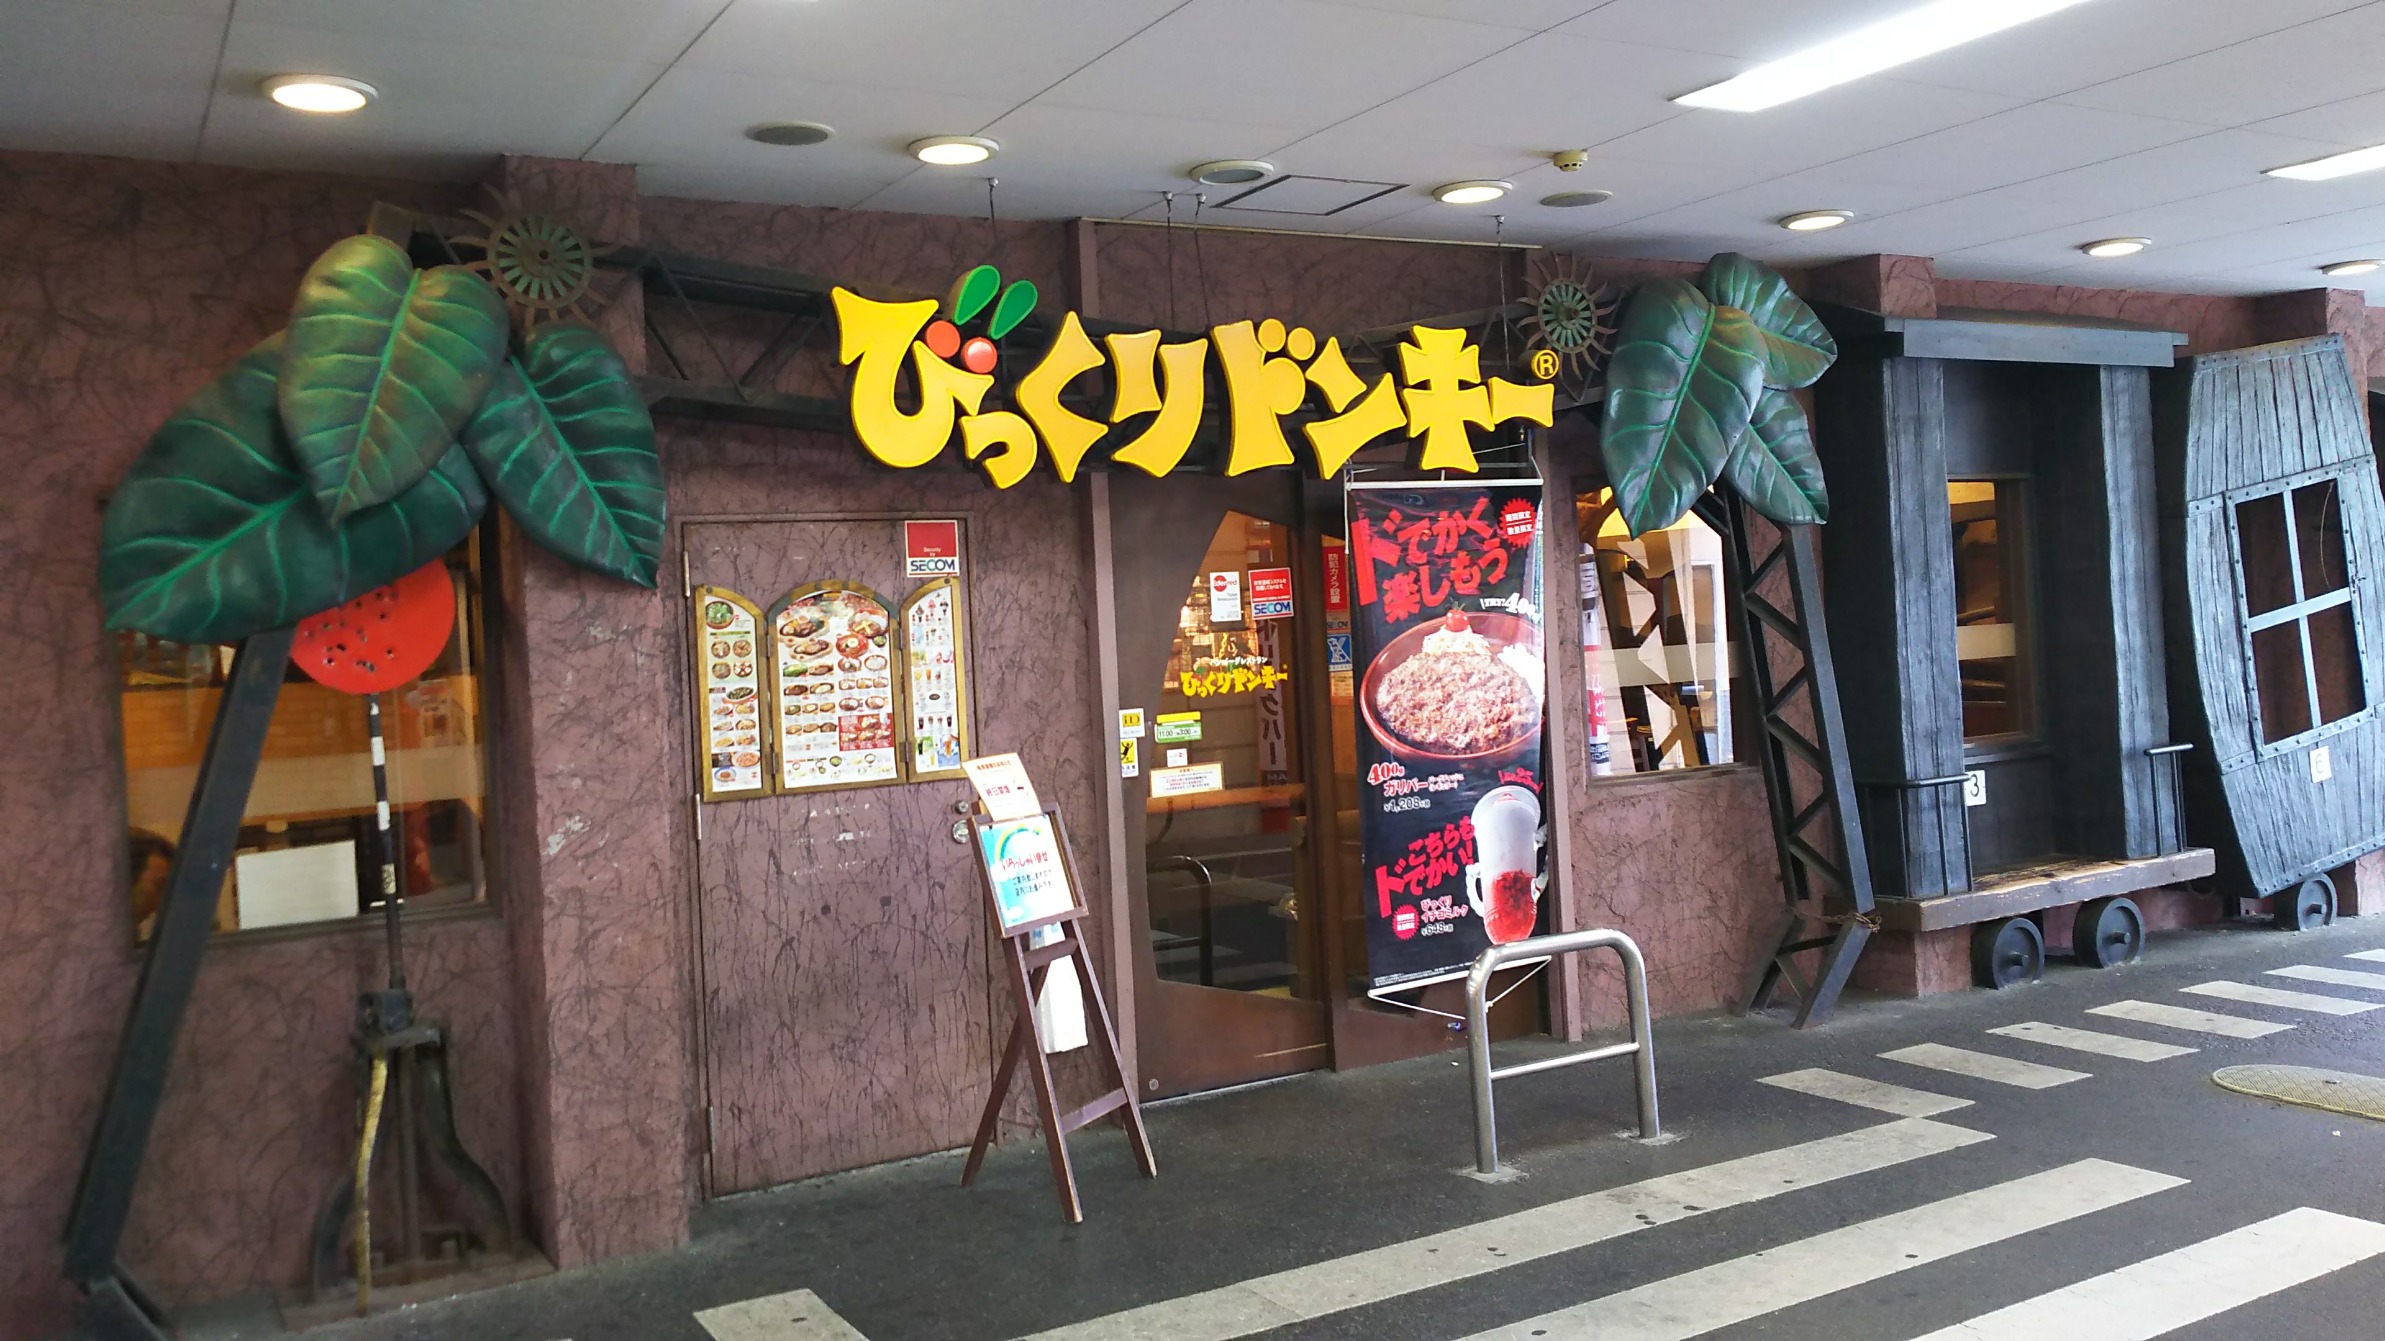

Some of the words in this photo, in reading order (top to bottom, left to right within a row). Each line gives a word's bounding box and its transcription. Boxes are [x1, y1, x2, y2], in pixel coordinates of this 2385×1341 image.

[831, 286, 1555, 489] びっくりドンキー
[910, 558, 955, 572] SECOM
[1351, 496, 1494, 606] ドでかく
[1328, 553, 1341, 604] 防犯カメラ設置
[1381, 537, 1508, 625] 楽しもう
[1254, 602, 1291, 615] SECOM
[1181, 665, 1288, 698] びっくりドンキー
[2315, 753, 2325, 774] 6
[1383, 777, 1429, 797] ガリバー
[1970, 773, 1980, 798] 3
[1408, 815, 1475, 866] こちらも
[1420, 904, 1469, 923] イチゴミルク
